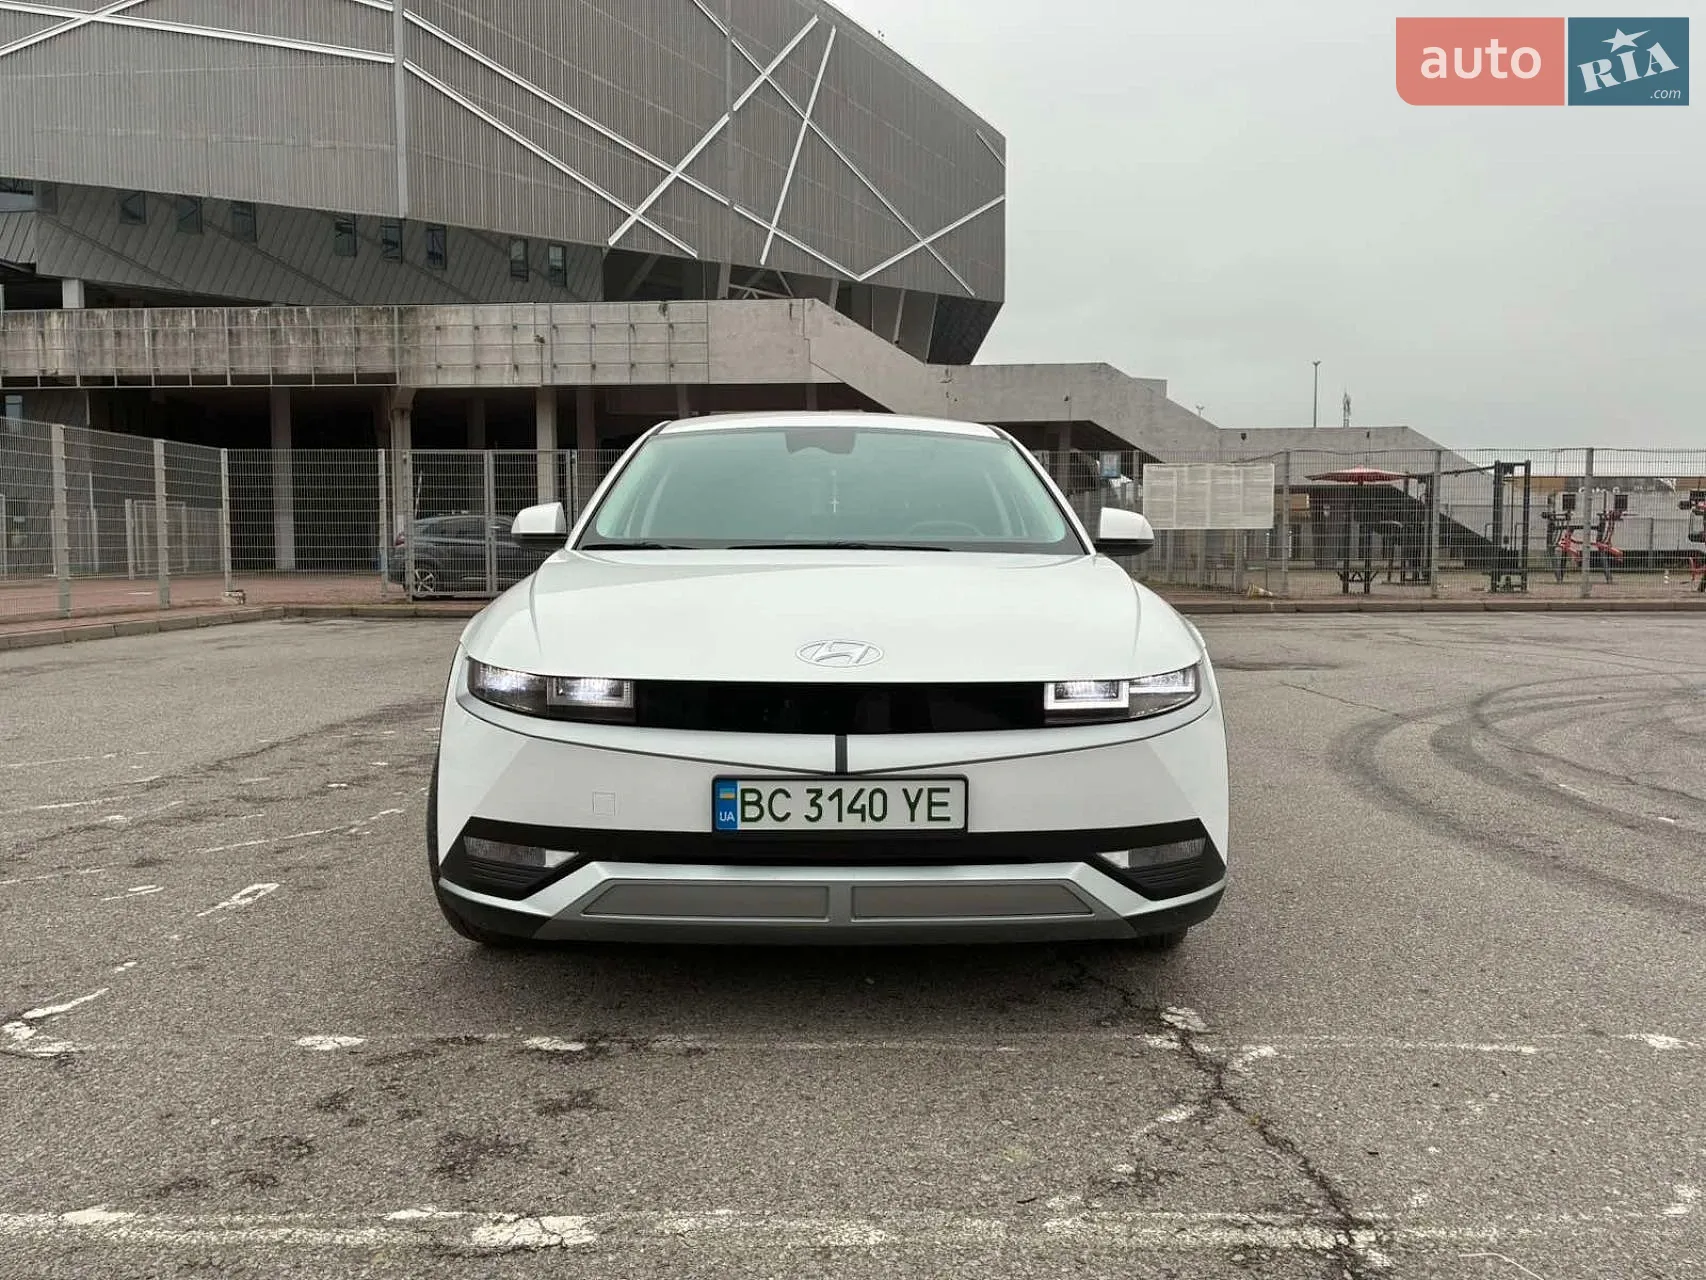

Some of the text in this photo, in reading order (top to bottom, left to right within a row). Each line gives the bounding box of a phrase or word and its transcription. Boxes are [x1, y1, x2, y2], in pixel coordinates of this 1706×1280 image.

[719, 811, 736, 822] UA
[740, 787, 951, 823] BC 3140 YE
